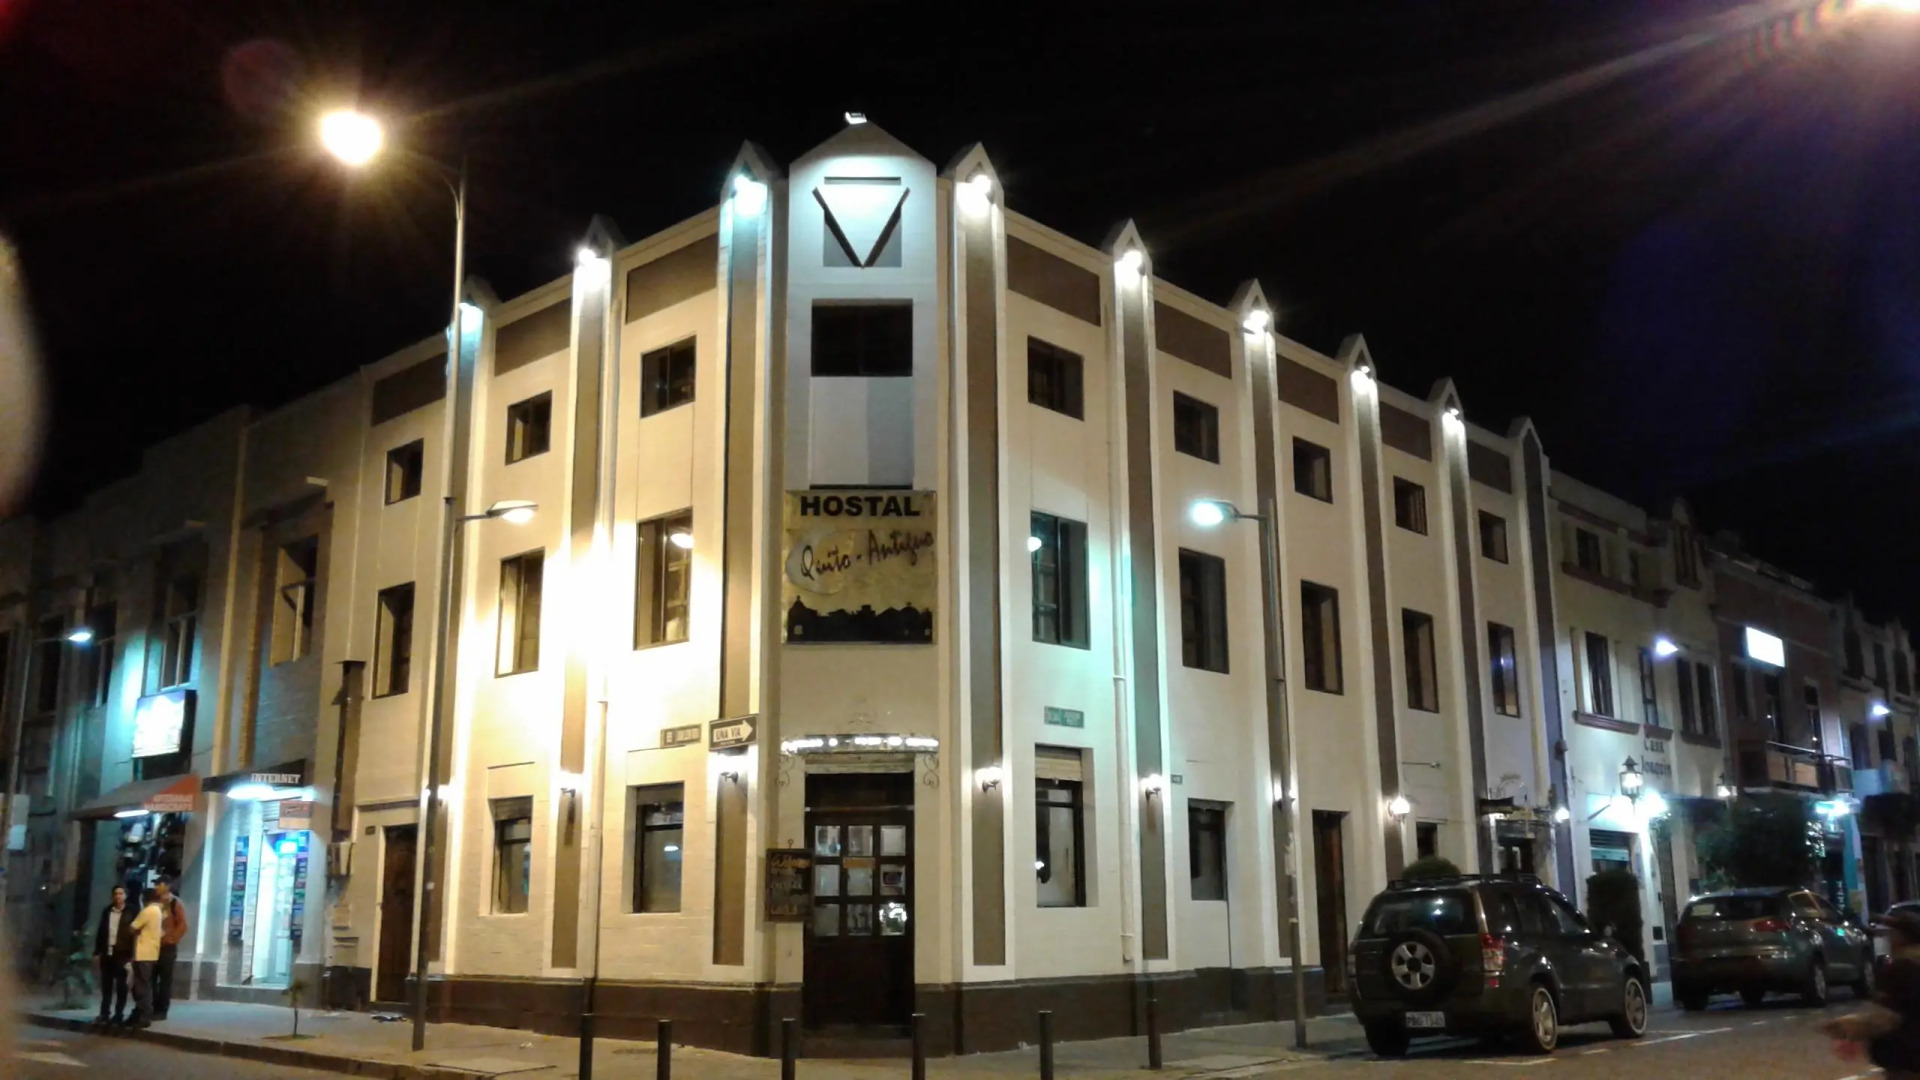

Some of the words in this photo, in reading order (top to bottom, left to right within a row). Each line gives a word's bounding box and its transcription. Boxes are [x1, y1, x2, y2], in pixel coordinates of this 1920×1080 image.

[801, 495, 920, 516] HOSTAL
[801, 545, 850, 581] Quito
[868, 529, 934, 566] Antiguo
[251, 773, 301, 784] INTERNET
